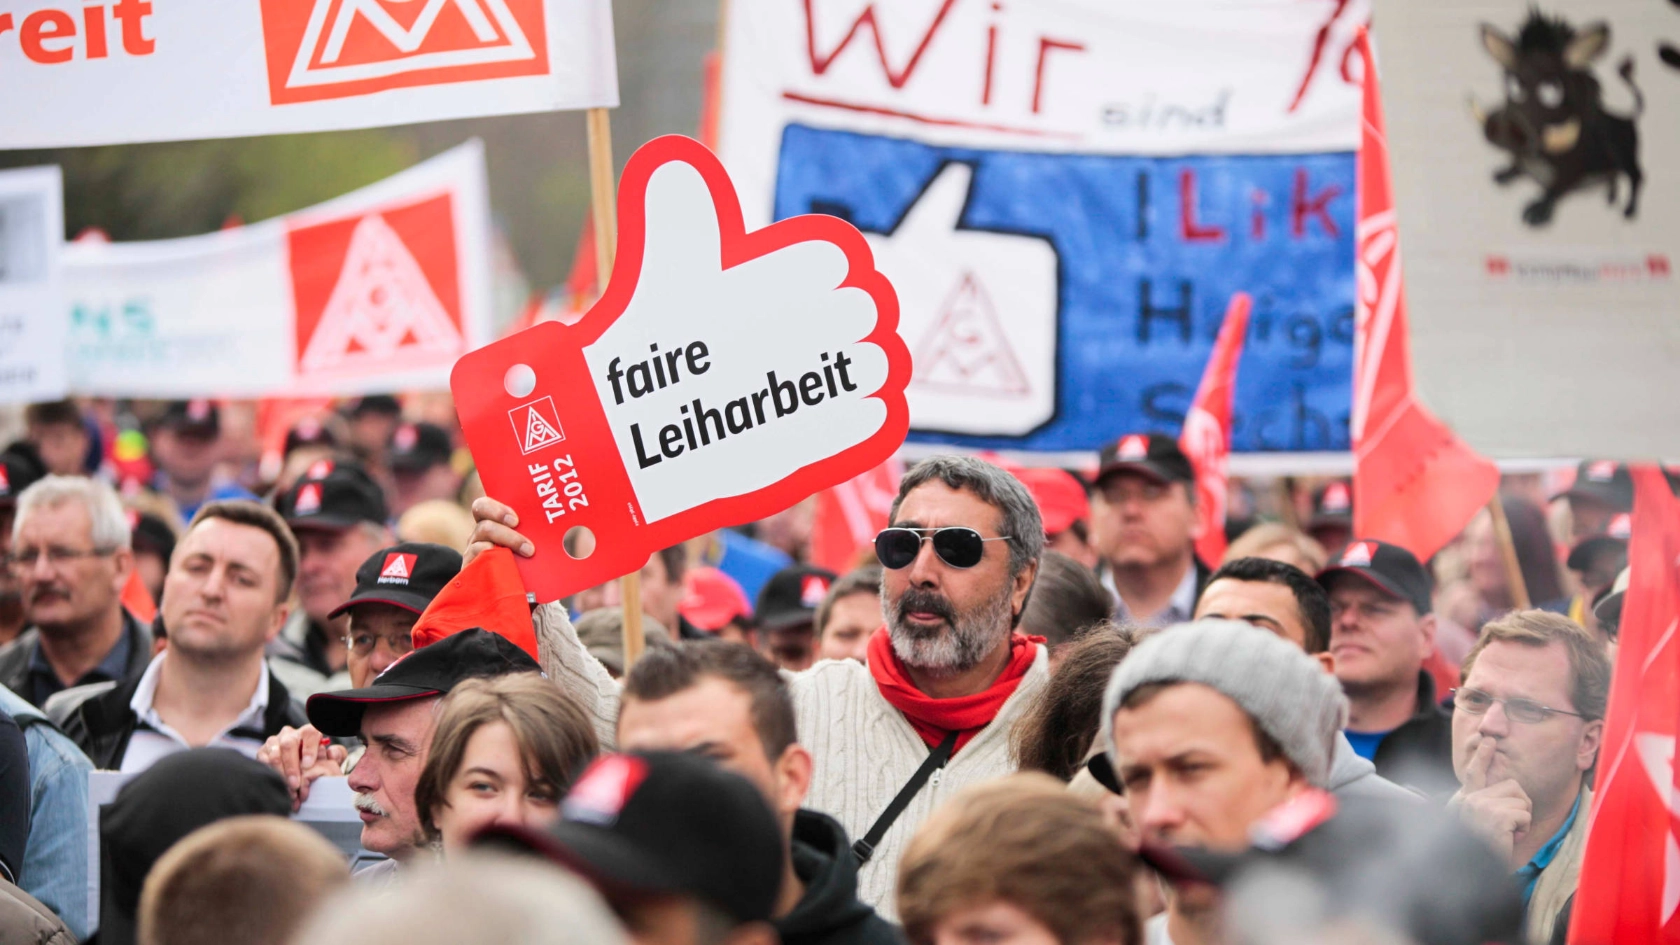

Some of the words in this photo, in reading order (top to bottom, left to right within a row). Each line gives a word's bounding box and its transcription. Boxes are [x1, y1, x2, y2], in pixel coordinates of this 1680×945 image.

[803, 0, 1086, 113] Wir
[1101, 87, 1234, 132] sind
[1178, 166, 1347, 243] Lik
[606, 340, 711, 406] faire
[629, 351, 858, 470] Leiharbeit
[528, 463, 566, 524] TARIF
[553, 453, 589, 511] 2012
